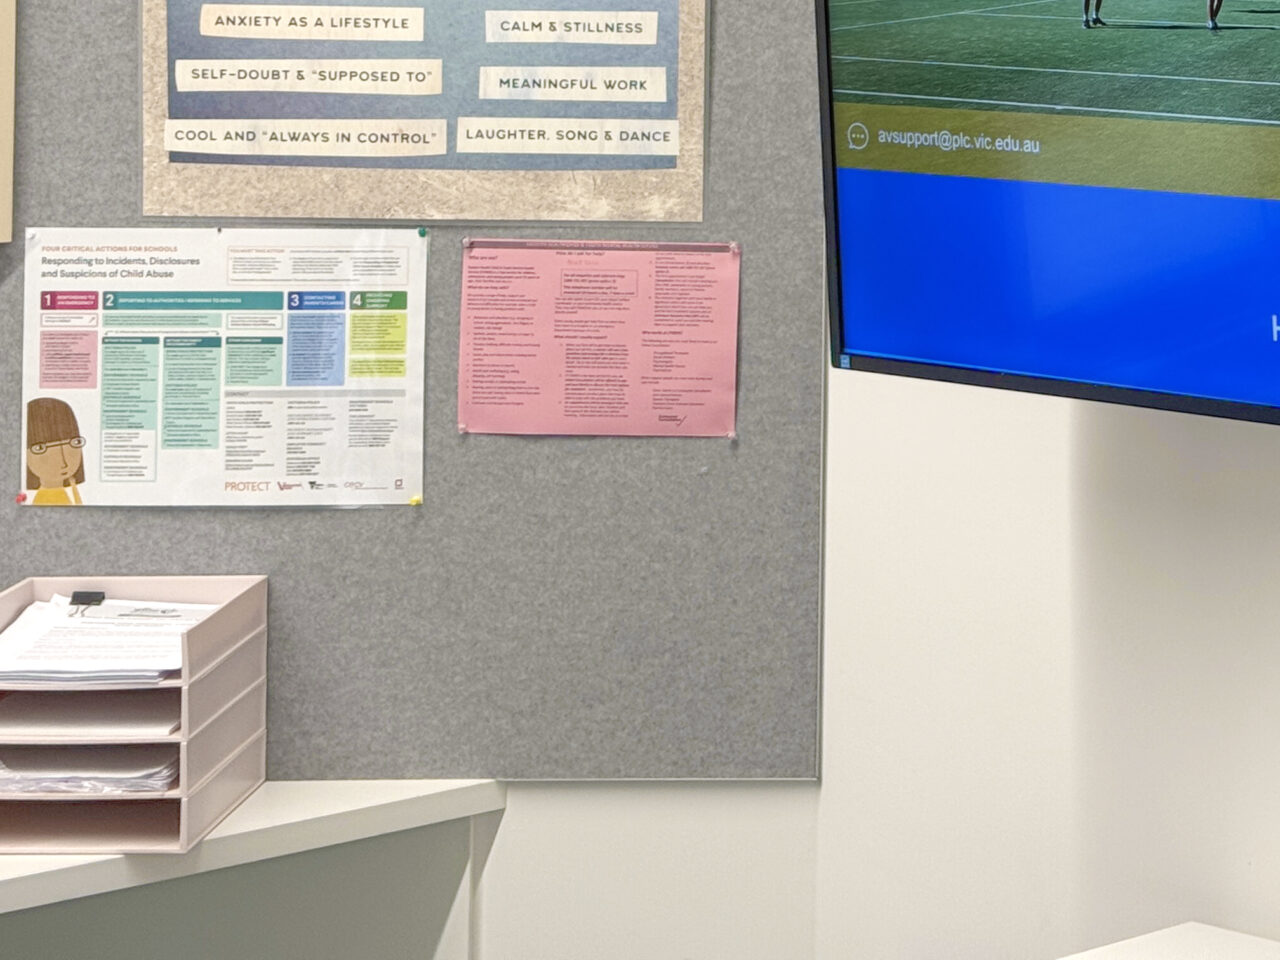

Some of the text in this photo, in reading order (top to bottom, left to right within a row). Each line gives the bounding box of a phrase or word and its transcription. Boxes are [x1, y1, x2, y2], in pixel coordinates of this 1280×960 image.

[214, 15, 409, 29] ANXIETY AS A LIFESTYLE
[500, 20, 643, 34] CALM & STILLNESS
[191, 68, 290, 81] SELF-DOUBT
[296, 69, 306, 81] &
[499, 77, 647, 91] MEANINGFUL WORK
[174, 130, 217, 141] COOL
[223, 130, 257, 142] AND
[336, 132, 351, 143] IN
[555, 129, 598, 141] SONG
[604, 130, 613, 142] &
[619, 130, 671, 142] DANCE
[878, 129, 1040, 153] avsupport@plc.vic.edu.au
[41, 256, 201, 266] Responding to Incidents, Disclosures
[41, 269, 175, 280] and Suspicions of Child Abuse
[44, 294, 51, 306] 1
[105, 294, 114, 306] 2
[290, 294, 299, 306] 3
[353, 294, 362, 306] 4
[224, 481, 271, 492] PROTECT
